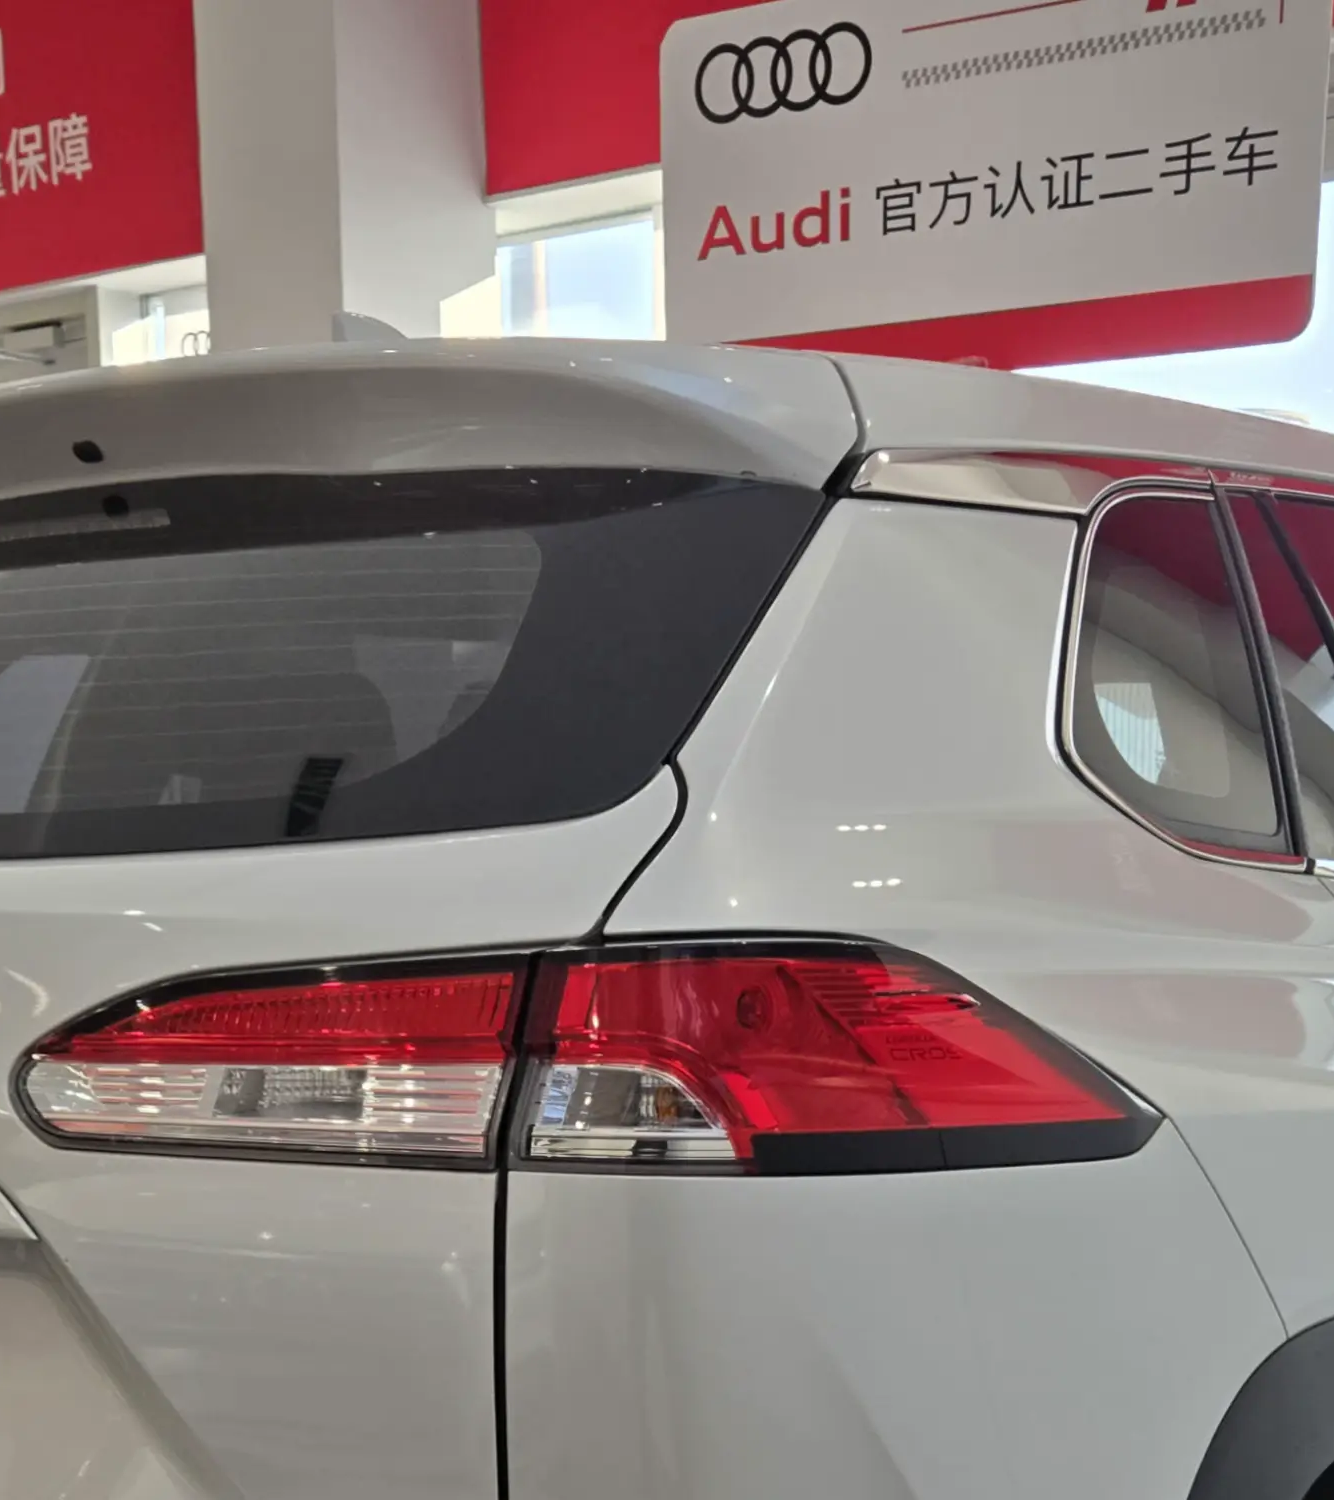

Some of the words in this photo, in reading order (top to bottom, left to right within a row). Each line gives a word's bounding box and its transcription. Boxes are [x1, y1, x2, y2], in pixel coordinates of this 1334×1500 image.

[697, 186, 852, 261] Audi
[875, 125, 1280, 237] 官方认证二手车
